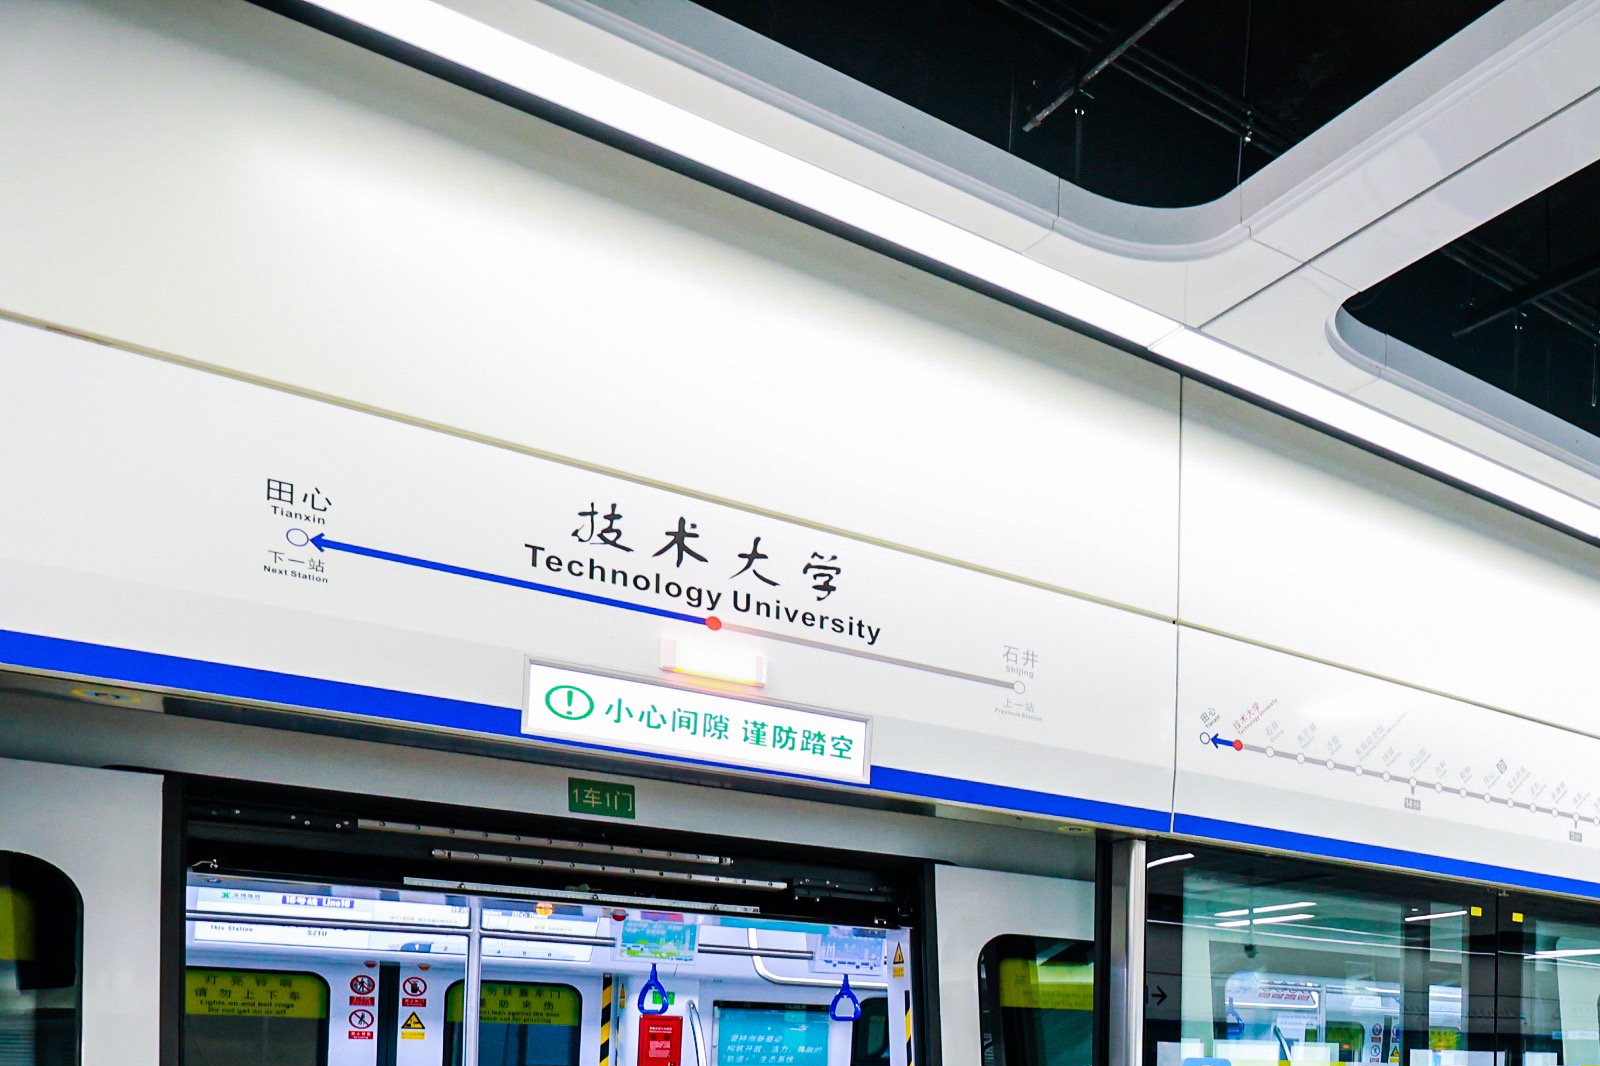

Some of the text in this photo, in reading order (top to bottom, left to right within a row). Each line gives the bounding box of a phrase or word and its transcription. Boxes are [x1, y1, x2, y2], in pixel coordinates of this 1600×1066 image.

[267, 478, 332, 512] 田心
[271, 505, 326, 525] Tianxin
[268, 550, 325, 573] 下一站
[571, 501, 842, 601] 技术大学
[263, 565, 328, 583] Next Station
[524, 543, 882, 645] Technology University
[1002, 645, 1039, 668] 石井
[1005, 665, 1034, 679] Shijing
[1003, 697, 1035, 713] 上一站
[605, 698, 854, 760] 小心间隙 谨防踏空
[573, 788, 632, 811] 1车1门
